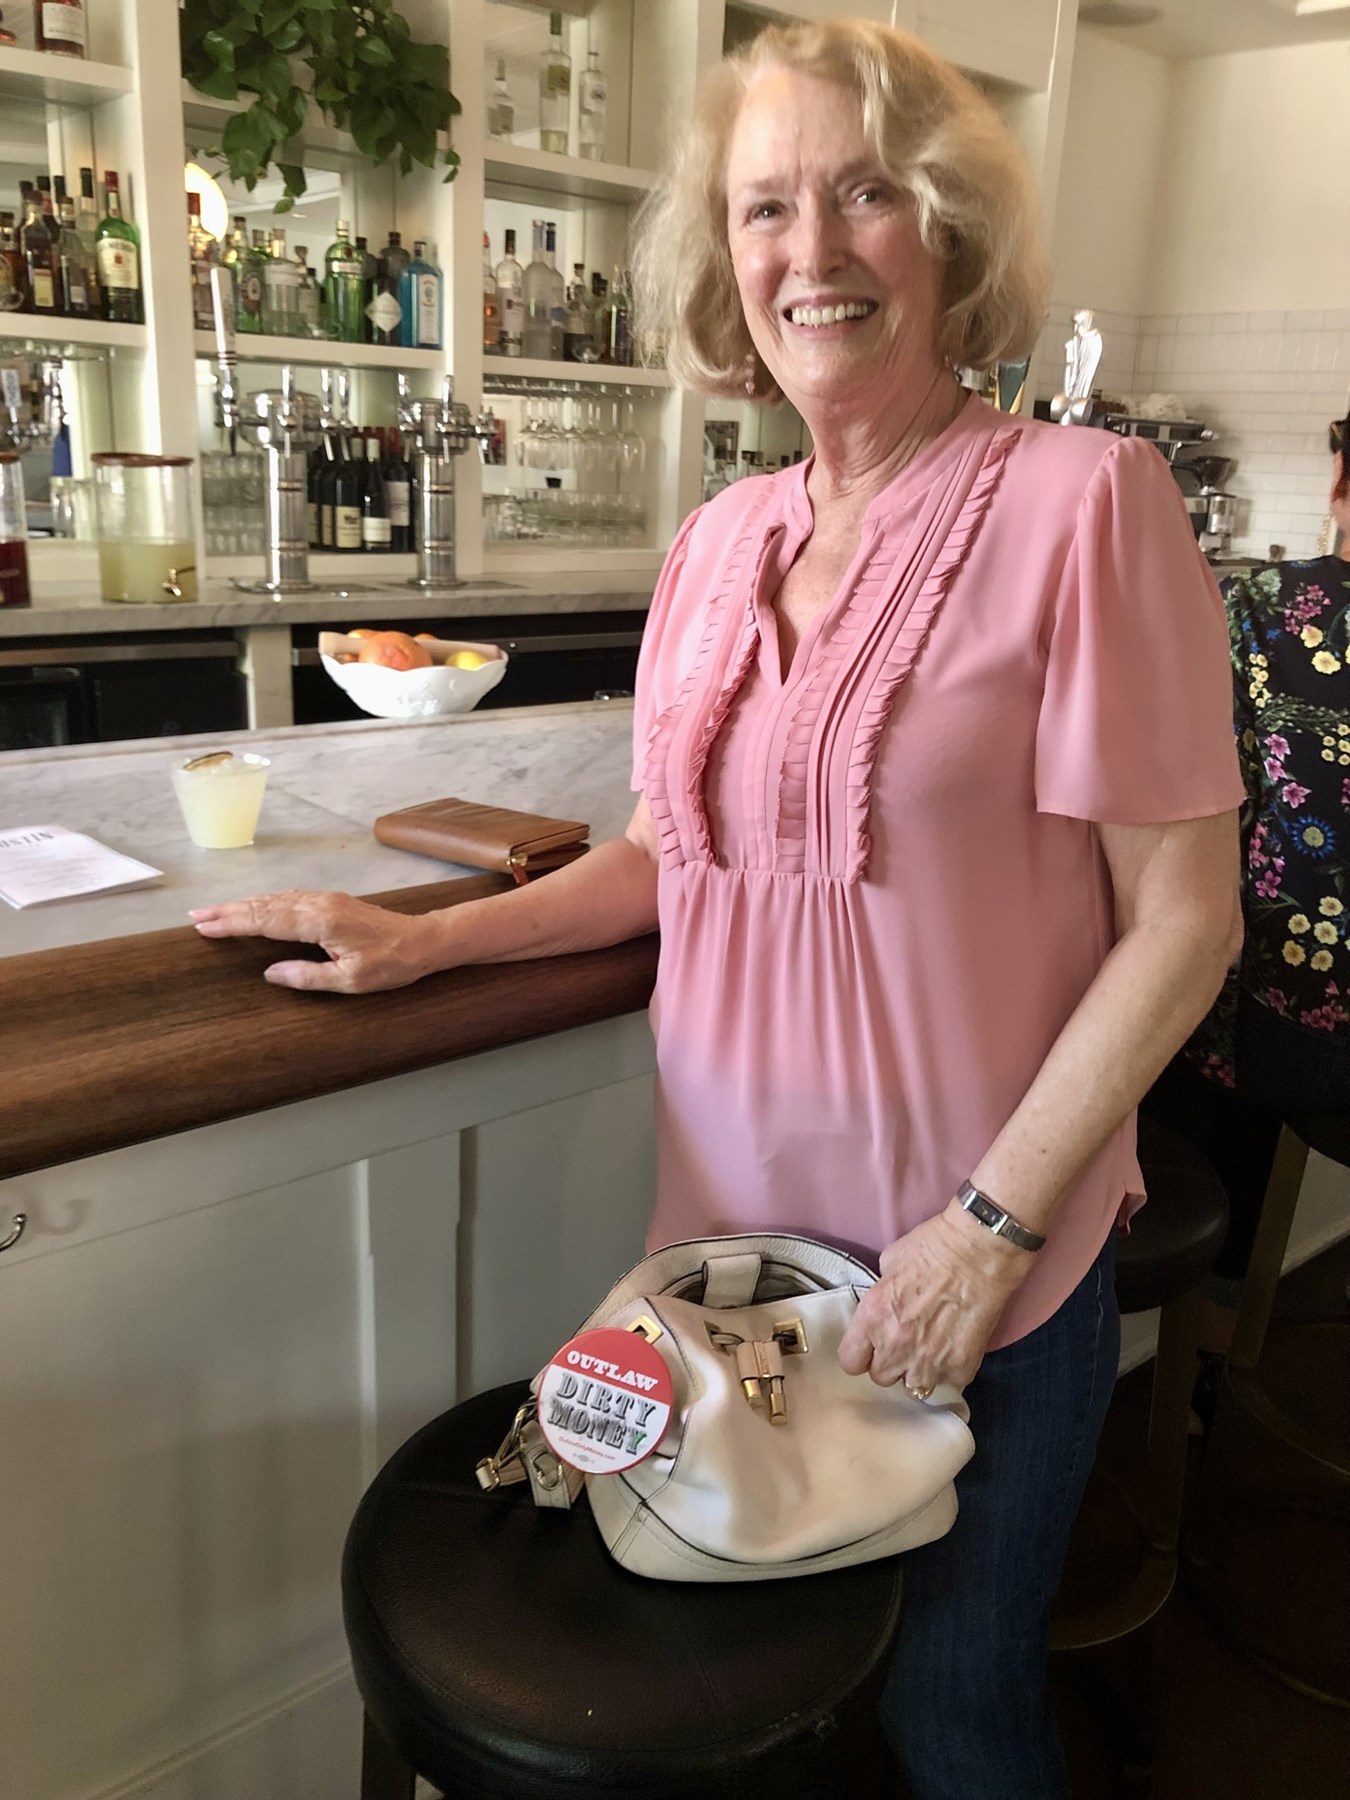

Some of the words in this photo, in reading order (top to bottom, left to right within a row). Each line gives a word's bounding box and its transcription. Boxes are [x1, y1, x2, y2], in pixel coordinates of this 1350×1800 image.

[0, 832, 54, 847] USTIN
[567, 1350, 658, 1391] OUTLAW
[556, 1371, 657, 1427] DIRTY
[548, 1398, 648, 1454] MONEY
